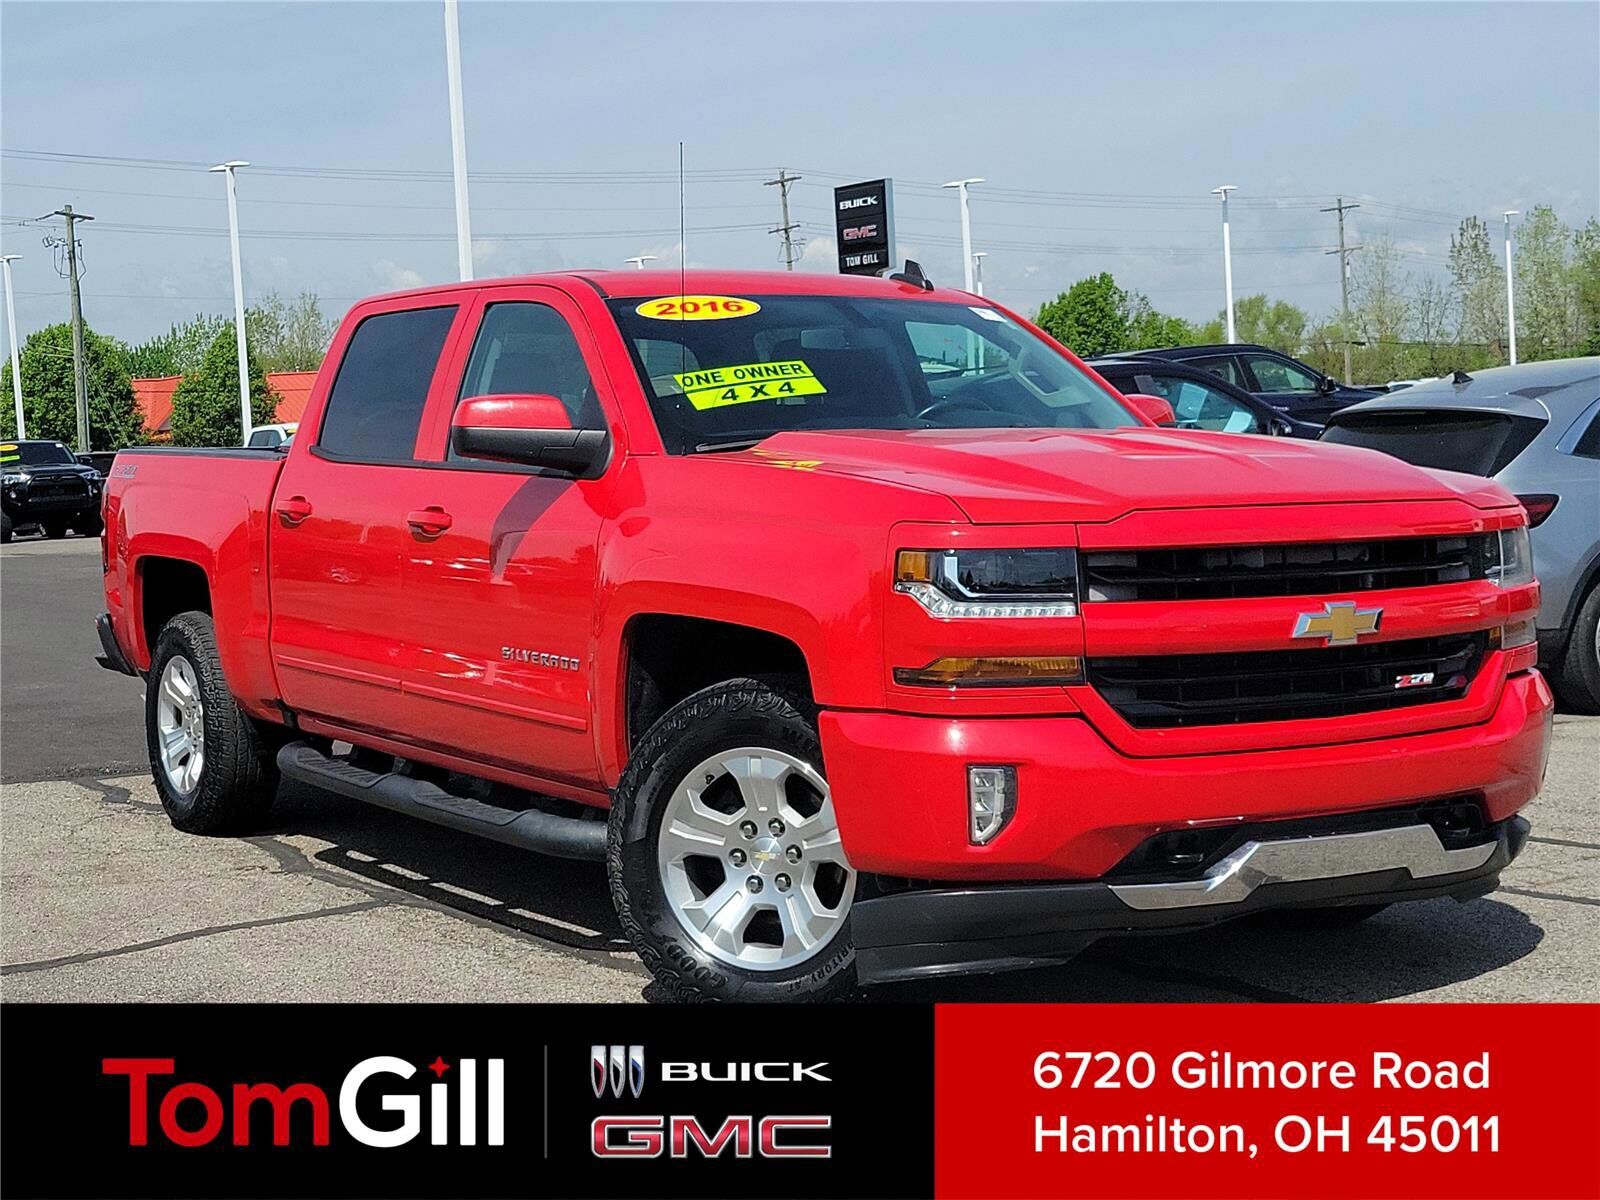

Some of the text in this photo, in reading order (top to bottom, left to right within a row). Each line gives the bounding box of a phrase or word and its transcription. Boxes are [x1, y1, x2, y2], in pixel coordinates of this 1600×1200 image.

[839, 195, 878, 210] BUICK
[842, 224, 877, 240] GMC
[845, 253, 879, 267] TOM GILL
[655, 301, 745, 316] 2016
[682, 363, 806, 387] ONE OWNER
[721, 388, 740, 402] 4
[778, 381, 796, 394] 4
[501, 646, 580, 672] SILVERADO
